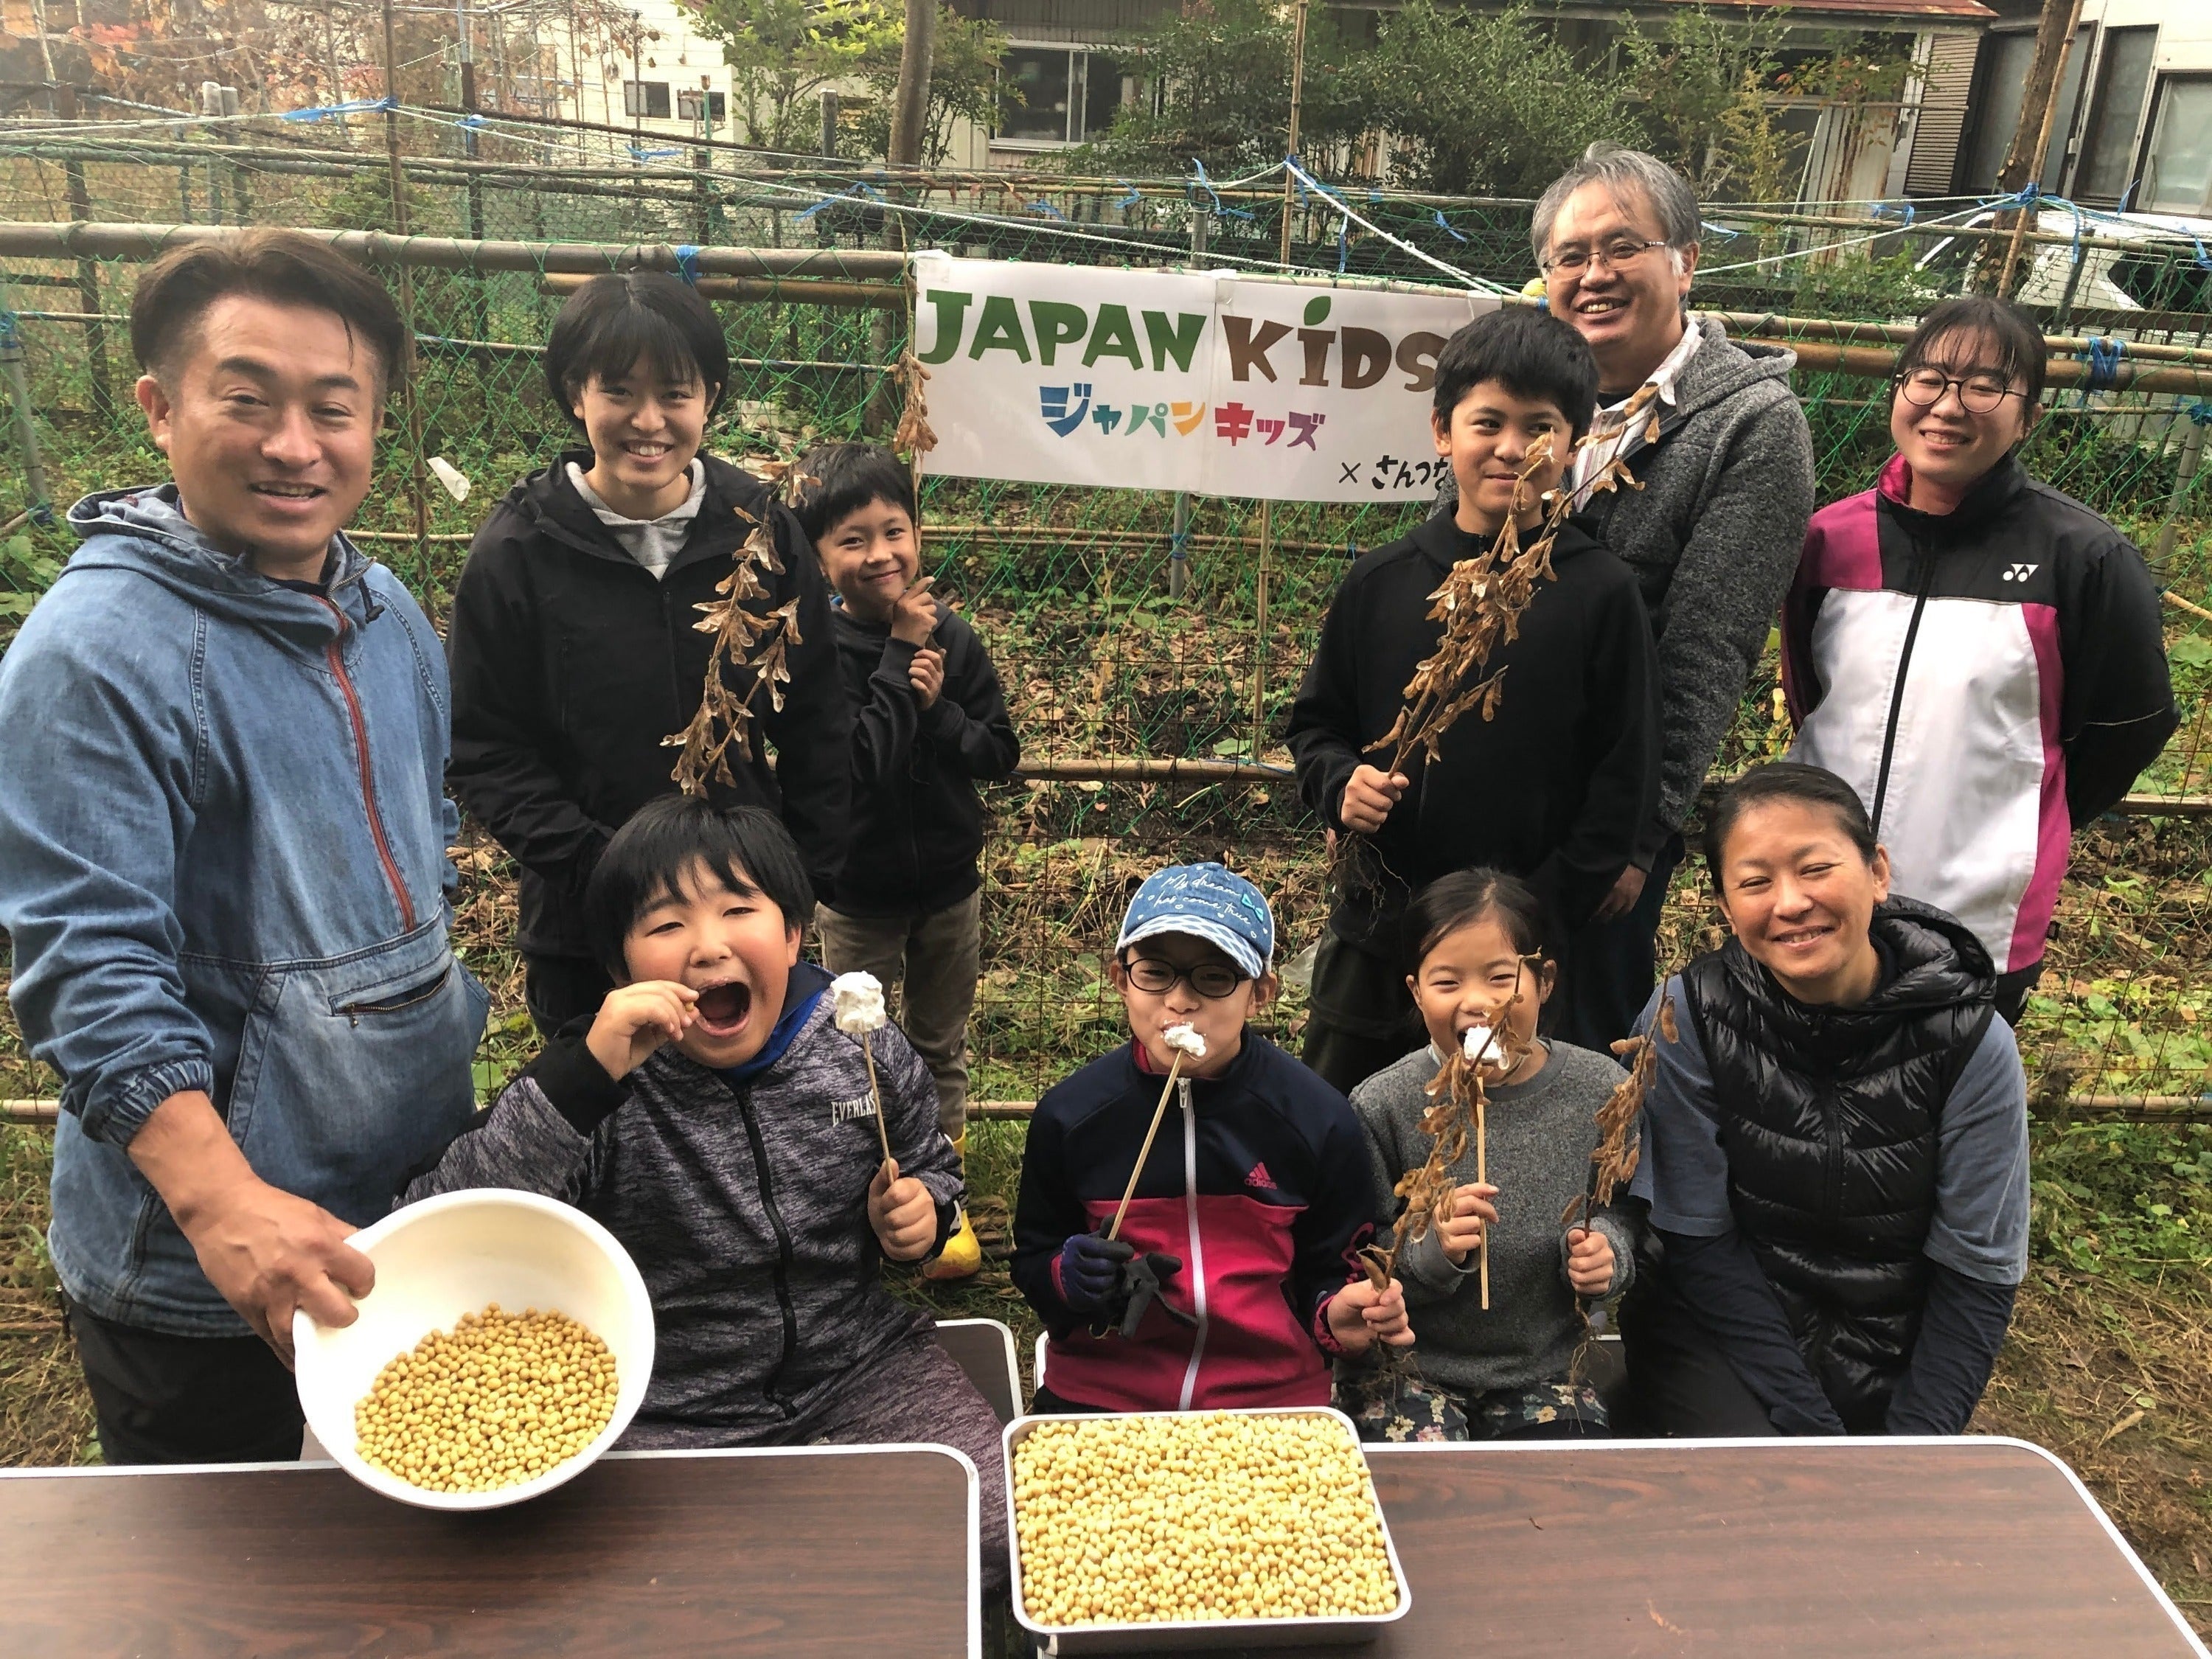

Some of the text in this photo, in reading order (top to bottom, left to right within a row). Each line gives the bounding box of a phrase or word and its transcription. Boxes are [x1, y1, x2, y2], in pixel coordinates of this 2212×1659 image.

[918, 289, 1207, 372] JAPAN
[1161, 872, 1240, 896] My dream
[1154, 891, 1178, 907] has
[1183, 897, 1222, 909] come
[831, 1088, 877, 1127] EVERLAS
[1244, 1178, 1277, 1189] adidas
